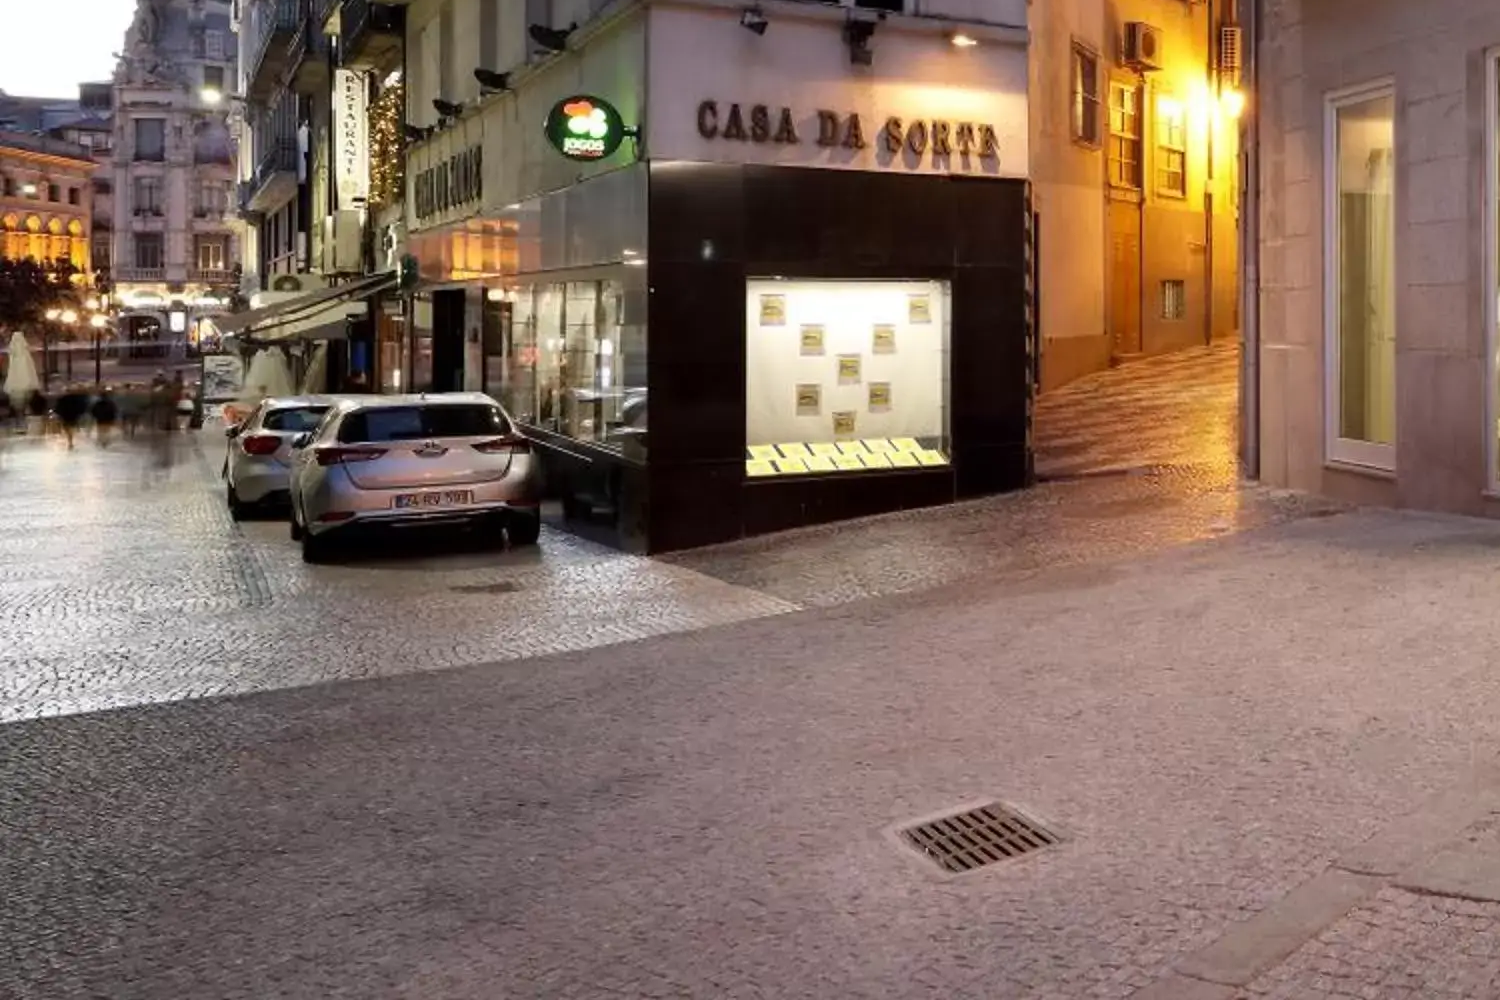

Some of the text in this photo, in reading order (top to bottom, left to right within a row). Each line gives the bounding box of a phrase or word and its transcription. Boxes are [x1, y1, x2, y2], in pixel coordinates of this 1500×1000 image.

[563, 137, 606, 152] JOGOS
[697, 100, 999, 158] CASA DA SORTE
